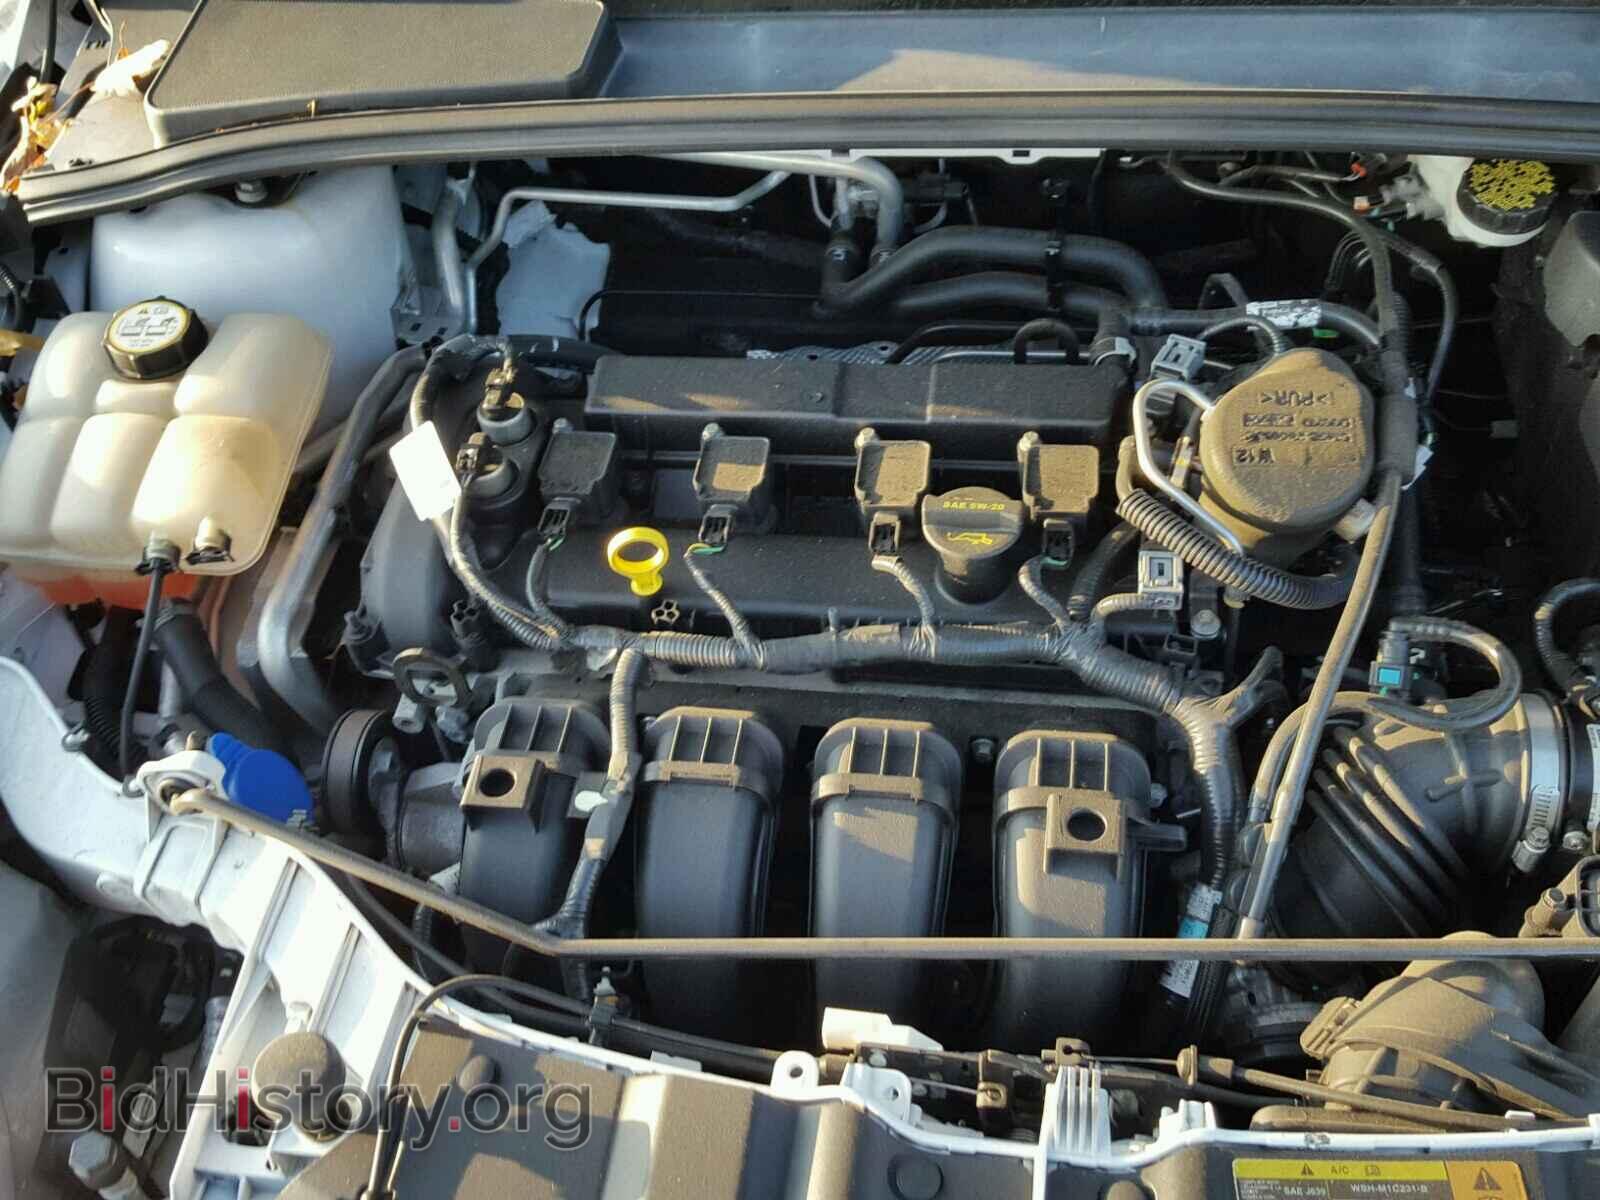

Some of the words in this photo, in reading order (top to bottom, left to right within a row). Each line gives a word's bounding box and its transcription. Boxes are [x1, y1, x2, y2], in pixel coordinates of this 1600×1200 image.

[943, 501, 967, 510] SAE
[970, 502, 1005, 511] 5W-20
[1330, 1166, 1351, 1175] A/C
